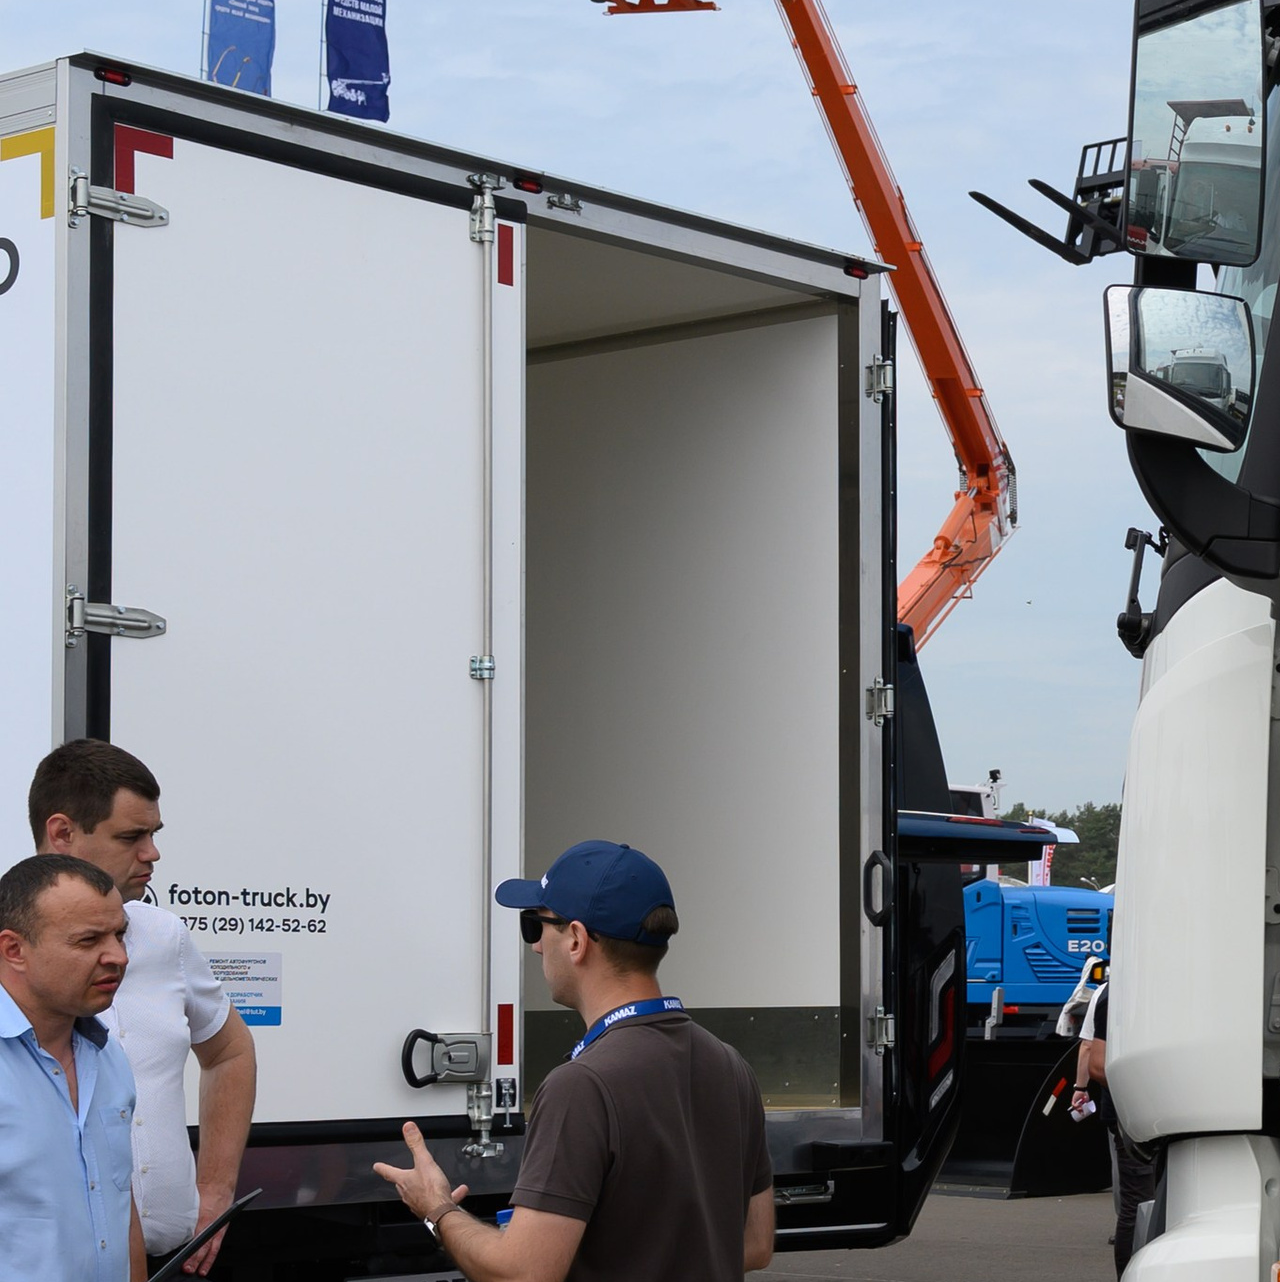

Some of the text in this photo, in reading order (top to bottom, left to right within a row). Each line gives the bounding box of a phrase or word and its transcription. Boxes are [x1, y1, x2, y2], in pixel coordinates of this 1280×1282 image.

[168, 883, 331, 914] foton-truck.by
[212, 916, 245, 935] (29)
[248, 917, 327, 934] 142-52-62
[603, 1005, 638, 1027] KAMAZ
